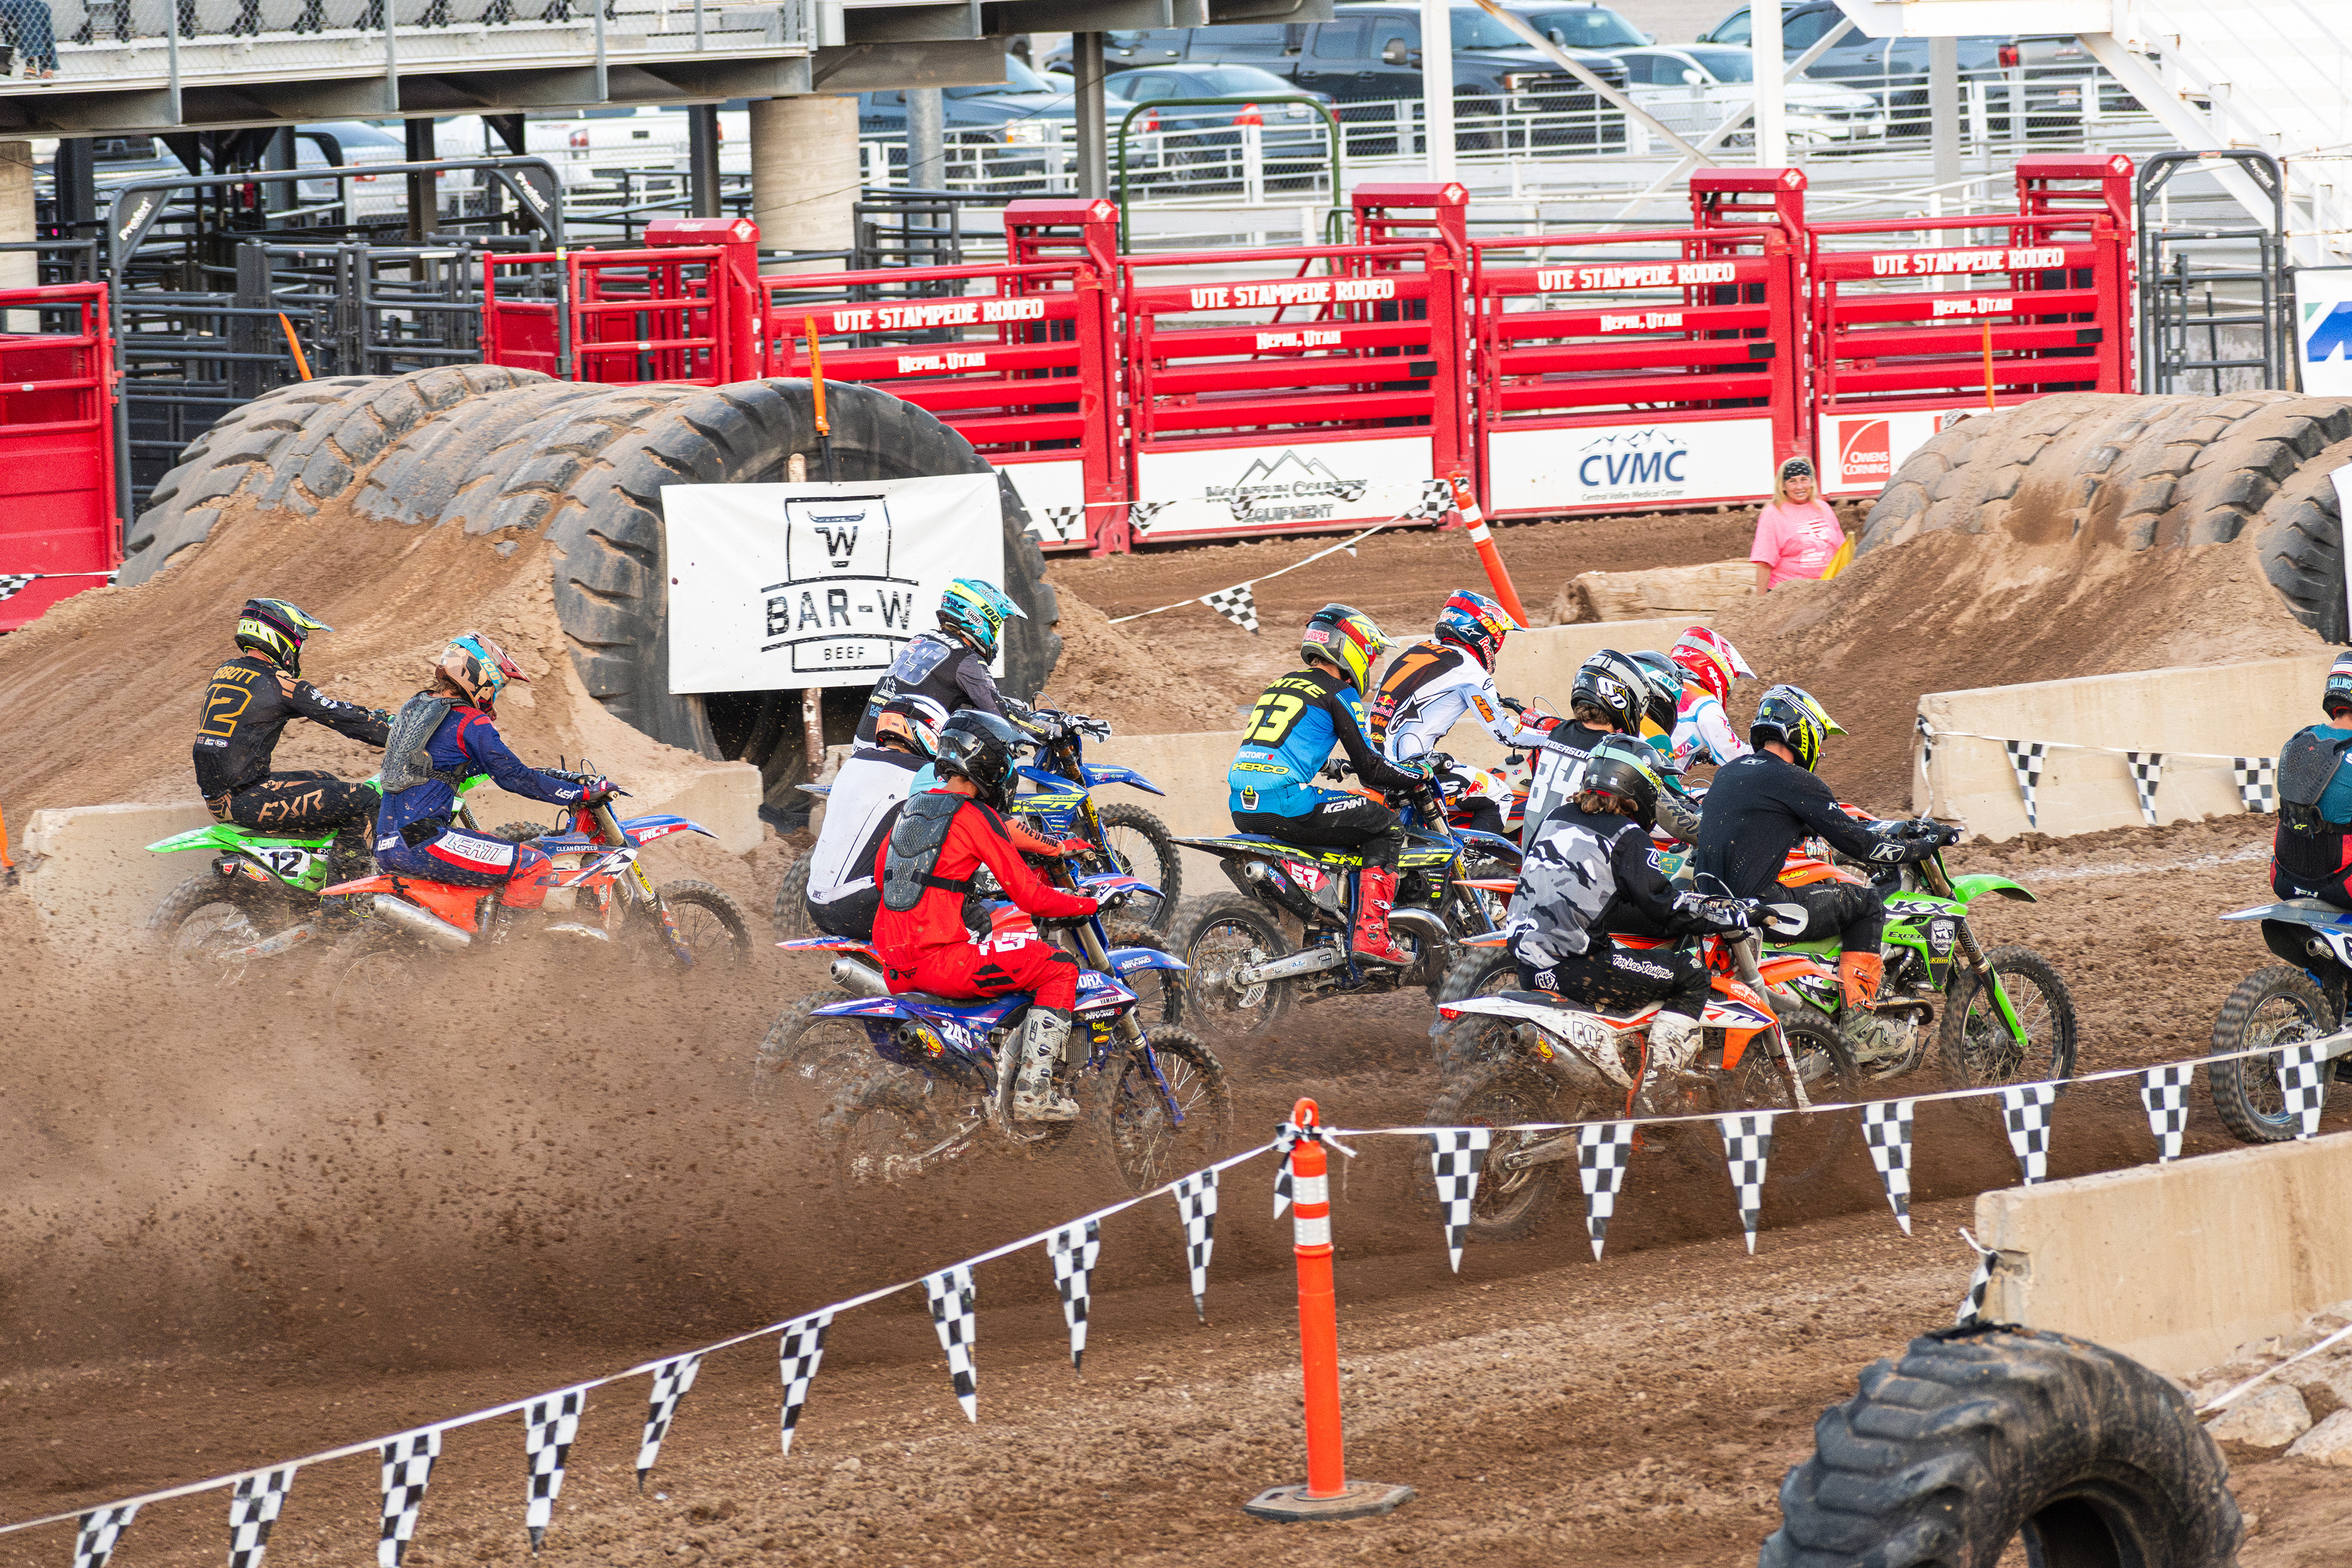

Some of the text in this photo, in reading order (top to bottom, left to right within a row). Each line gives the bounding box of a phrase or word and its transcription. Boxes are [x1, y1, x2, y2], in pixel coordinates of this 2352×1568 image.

[1872, 248, 2065, 275] UTE STAMPEDE RODEO
[1537, 263, 1736, 290] UTE STAMPEDE RODEO
[1191, 279, 1395, 309] UTE STAMPEDE RODEO
[834, 298, 1045, 331] UTE STAMPEDE RODEO
[1850, 451, 1889, 462] OWENS
[1580, 450, 1688, 486] CVMC
[1843, 463, 1890, 475] CORNING
[1610, 491, 1630, 500] Valley
[1632, 490, 1659, 499] Medical
[1661, 489, 1684, 497] Center
[767, 588, 913, 637] BAR-W
[966, 609, 982, 625] SHOEI
[980, 603, 1001, 628] 100%
[1476, 611, 1504, 644] 100%
[824, 646, 865, 660] BEEF
[1381, 654, 1440, 693] 1
[1706, 646, 1735, 685] 100%
[1267, 677, 1327, 699] NTZE
[1242, 693, 1305, 742] 53
[1471, 695, 1496, 723] KTM
[1009, 714, 1045, 734] SHERCO
[1371, 714, 1389, 728] KTM
[1238, 751, 1267, 760] FACTORY
[1231, 763, 1289, 775] SHERCO
[1384, 760, 1420, 779] SHERCO
[1526, 748, 1588, 813] 84
[257, 788, 323, 823] FXR
[1322, 797, 1368, 814] KENNY
[464, 808, 478, 830] SHOWA
[1016, 821, 1034, 837] FIVE
[377, 835, 399, 851] LEATT
[639, 829, 660, 842] IRC
[445, 834, 509, 862] LEATT
[268, 851, 304, 880] 12
[1291, 862, 1320, 891] 53
[1778, 870, 1808, 881] FMF
[1893, 900, 1951, 916] KX
[1888, 930, 1924, 939] EXCEL
[1626, 959, 1641, 973] Lee
[1642, 962, 1674, 981] Designs
[1099, 995, 1119, 1005] YAMAHA
[941, 1019, 973, 1050] 243
